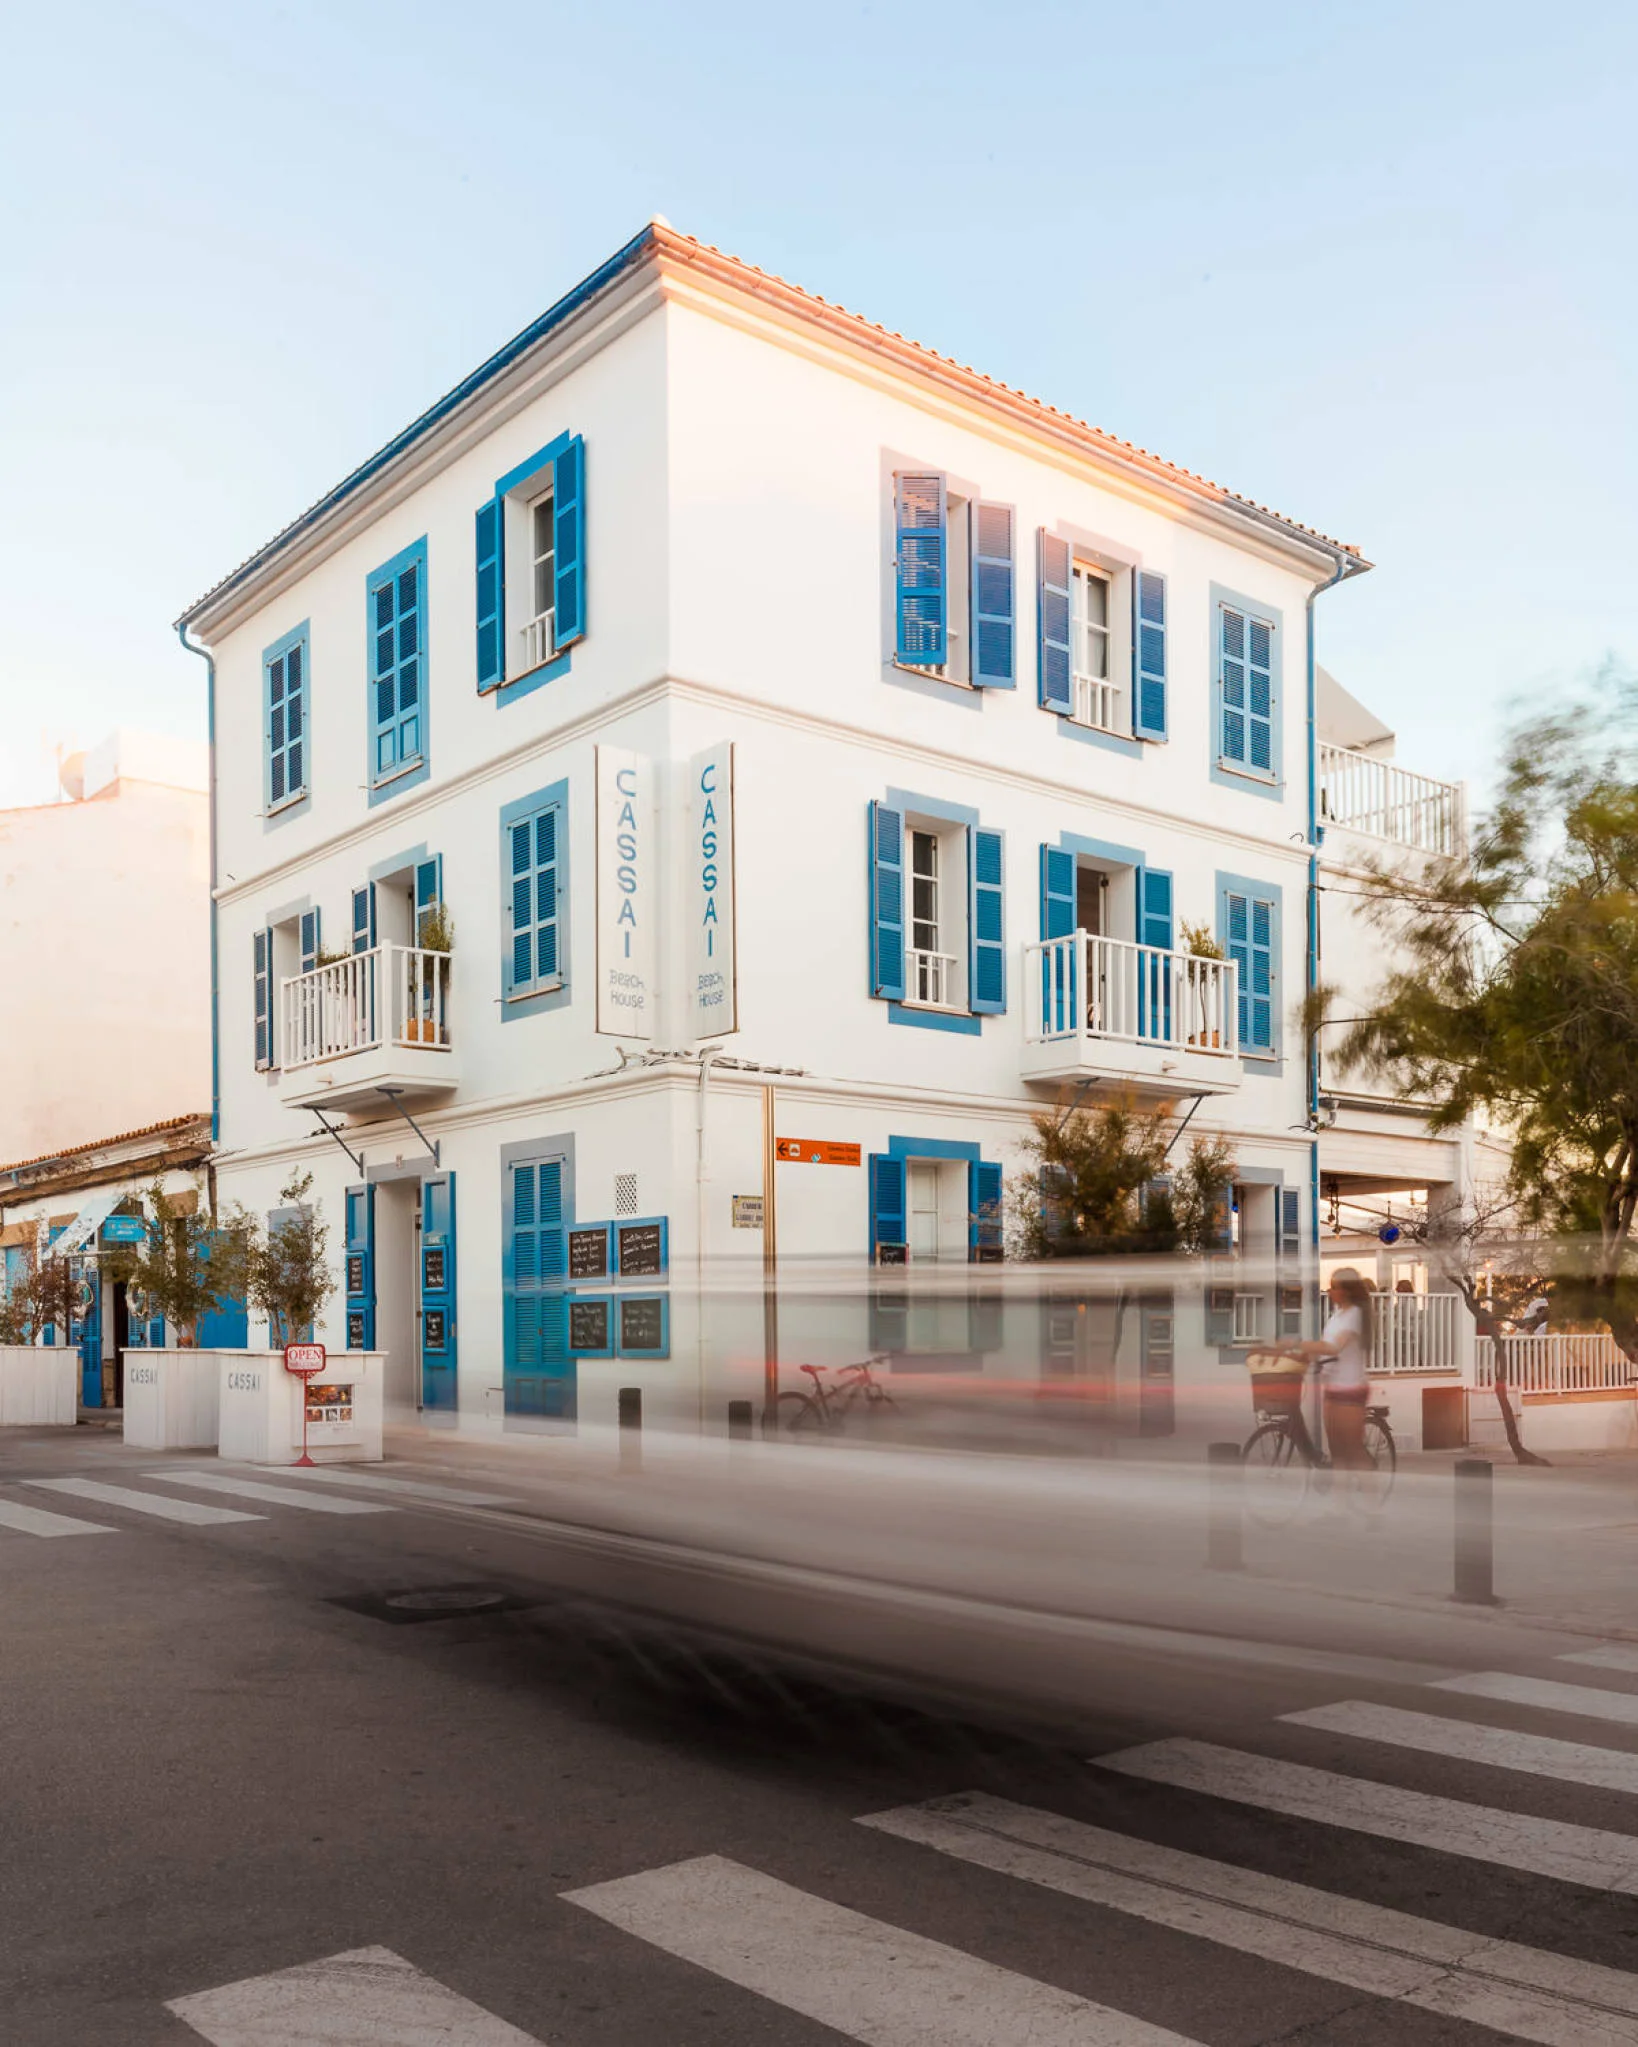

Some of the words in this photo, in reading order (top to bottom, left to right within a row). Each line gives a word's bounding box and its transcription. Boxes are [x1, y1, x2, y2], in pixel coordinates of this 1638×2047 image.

[616, 769, 637, 958] CASSAI
[701, 764, 718, 957] CASSAI
[289, 1349, 322, 1360] OPEN
[130, 1368, 158, 1385] CASSAI
[228, 1372, 260, 1392] CASSAI
